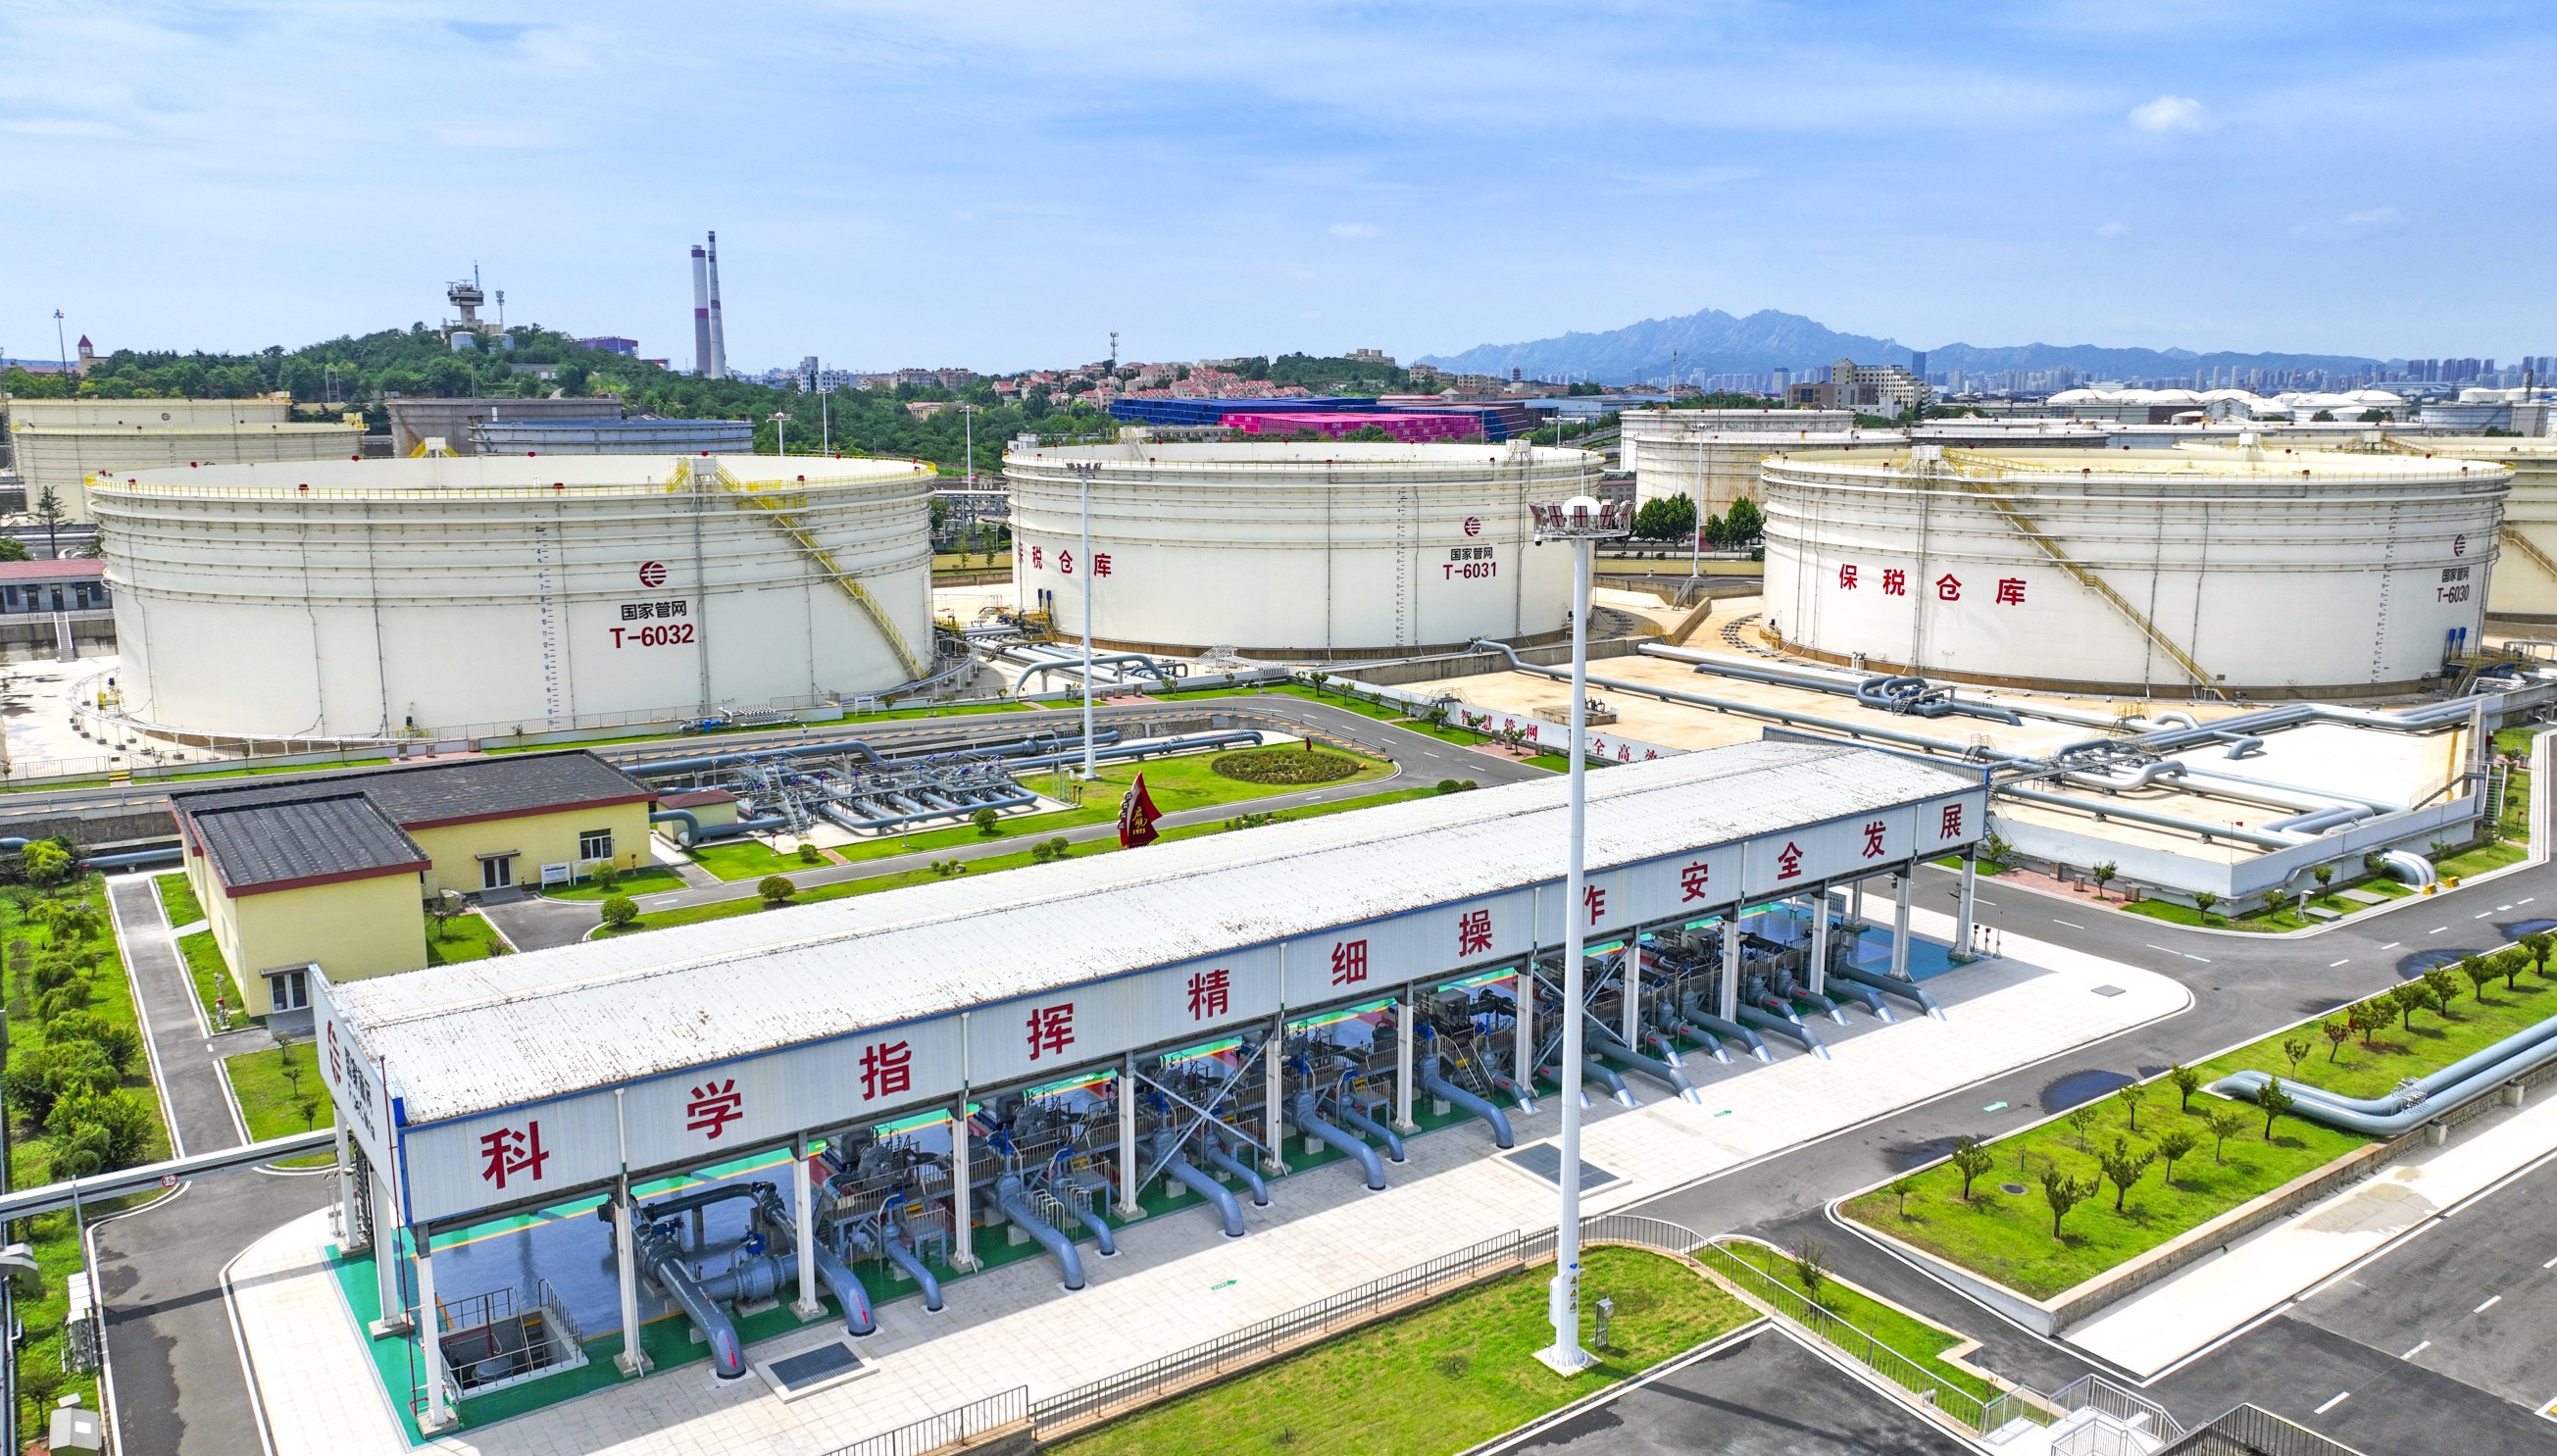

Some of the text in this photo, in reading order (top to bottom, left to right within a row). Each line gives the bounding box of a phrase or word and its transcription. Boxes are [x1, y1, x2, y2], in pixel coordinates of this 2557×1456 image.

[1451, 546, 1493, 562] 国家管网
[1443, 562, 1496, 579] T-6031
[1839, 564, 2027, 606] 保税仓库
[2437, 584, 2470, 603] T-6030
[621, 600, 687, 621] 国家管网
[609, 623, 694, 648] T-6032
